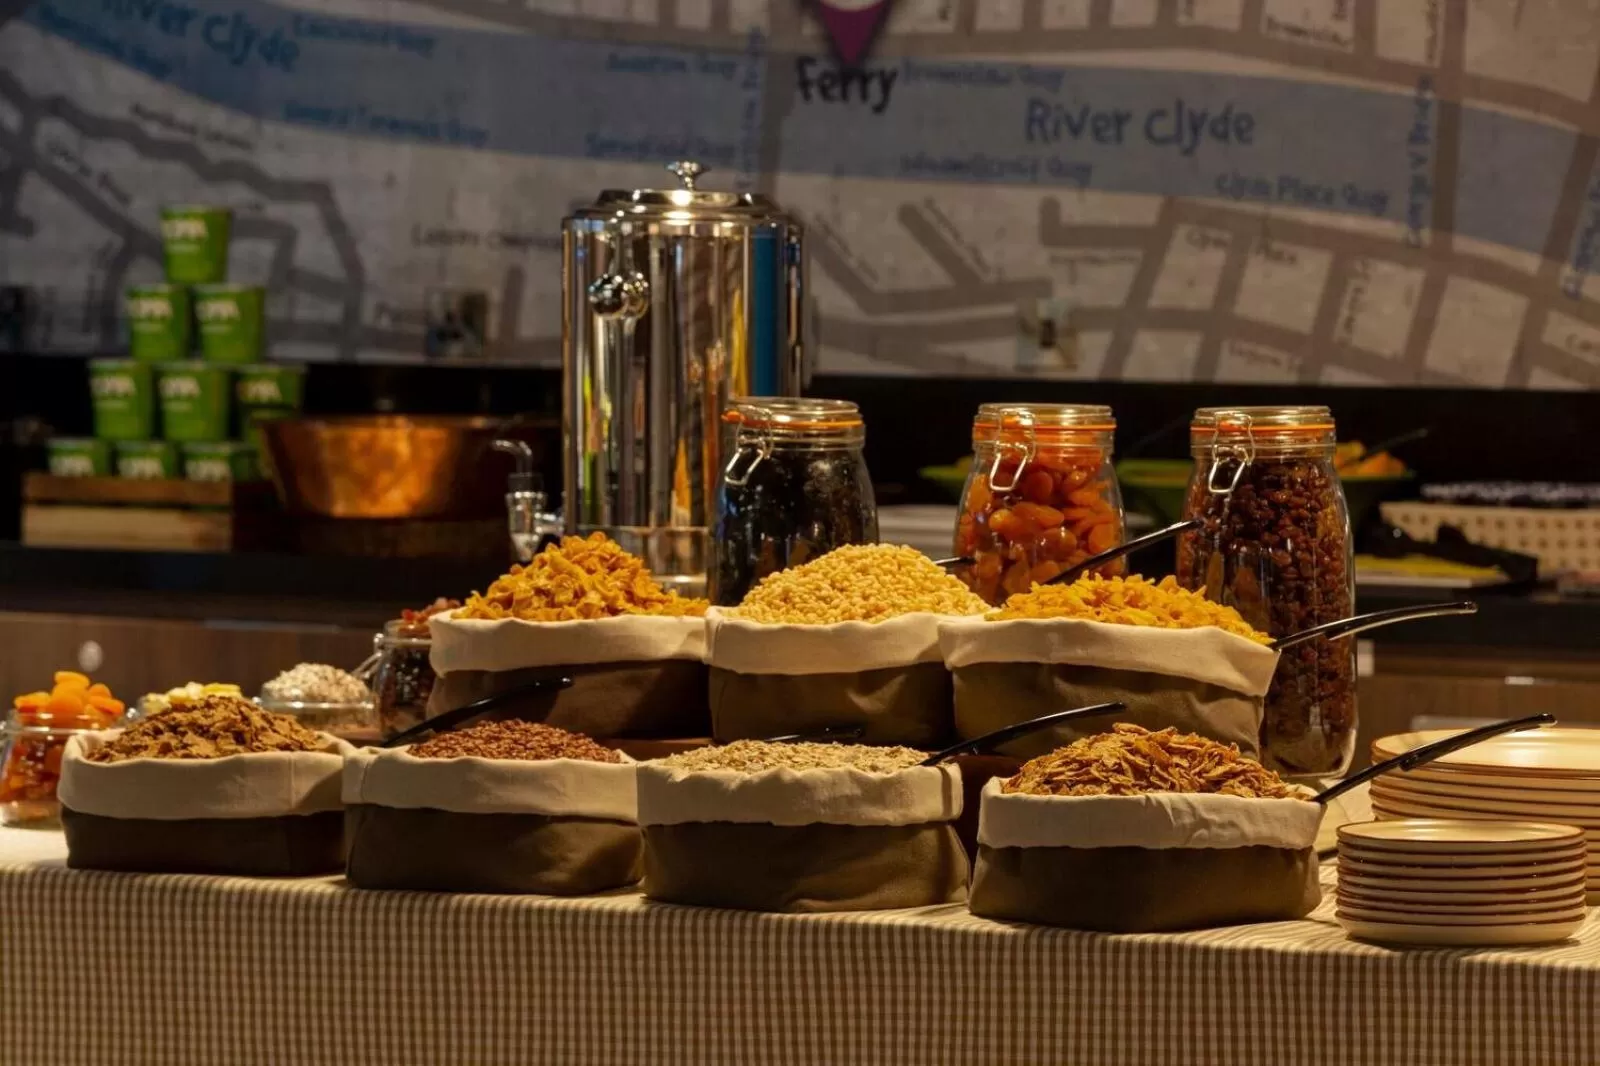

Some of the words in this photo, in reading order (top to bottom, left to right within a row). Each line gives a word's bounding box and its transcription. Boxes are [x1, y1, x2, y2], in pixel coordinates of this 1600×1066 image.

[203, 10, 299, 72] Clyde
[796, 54, 898, 116] Ferry
[1025, 96, 1132, 144] River
